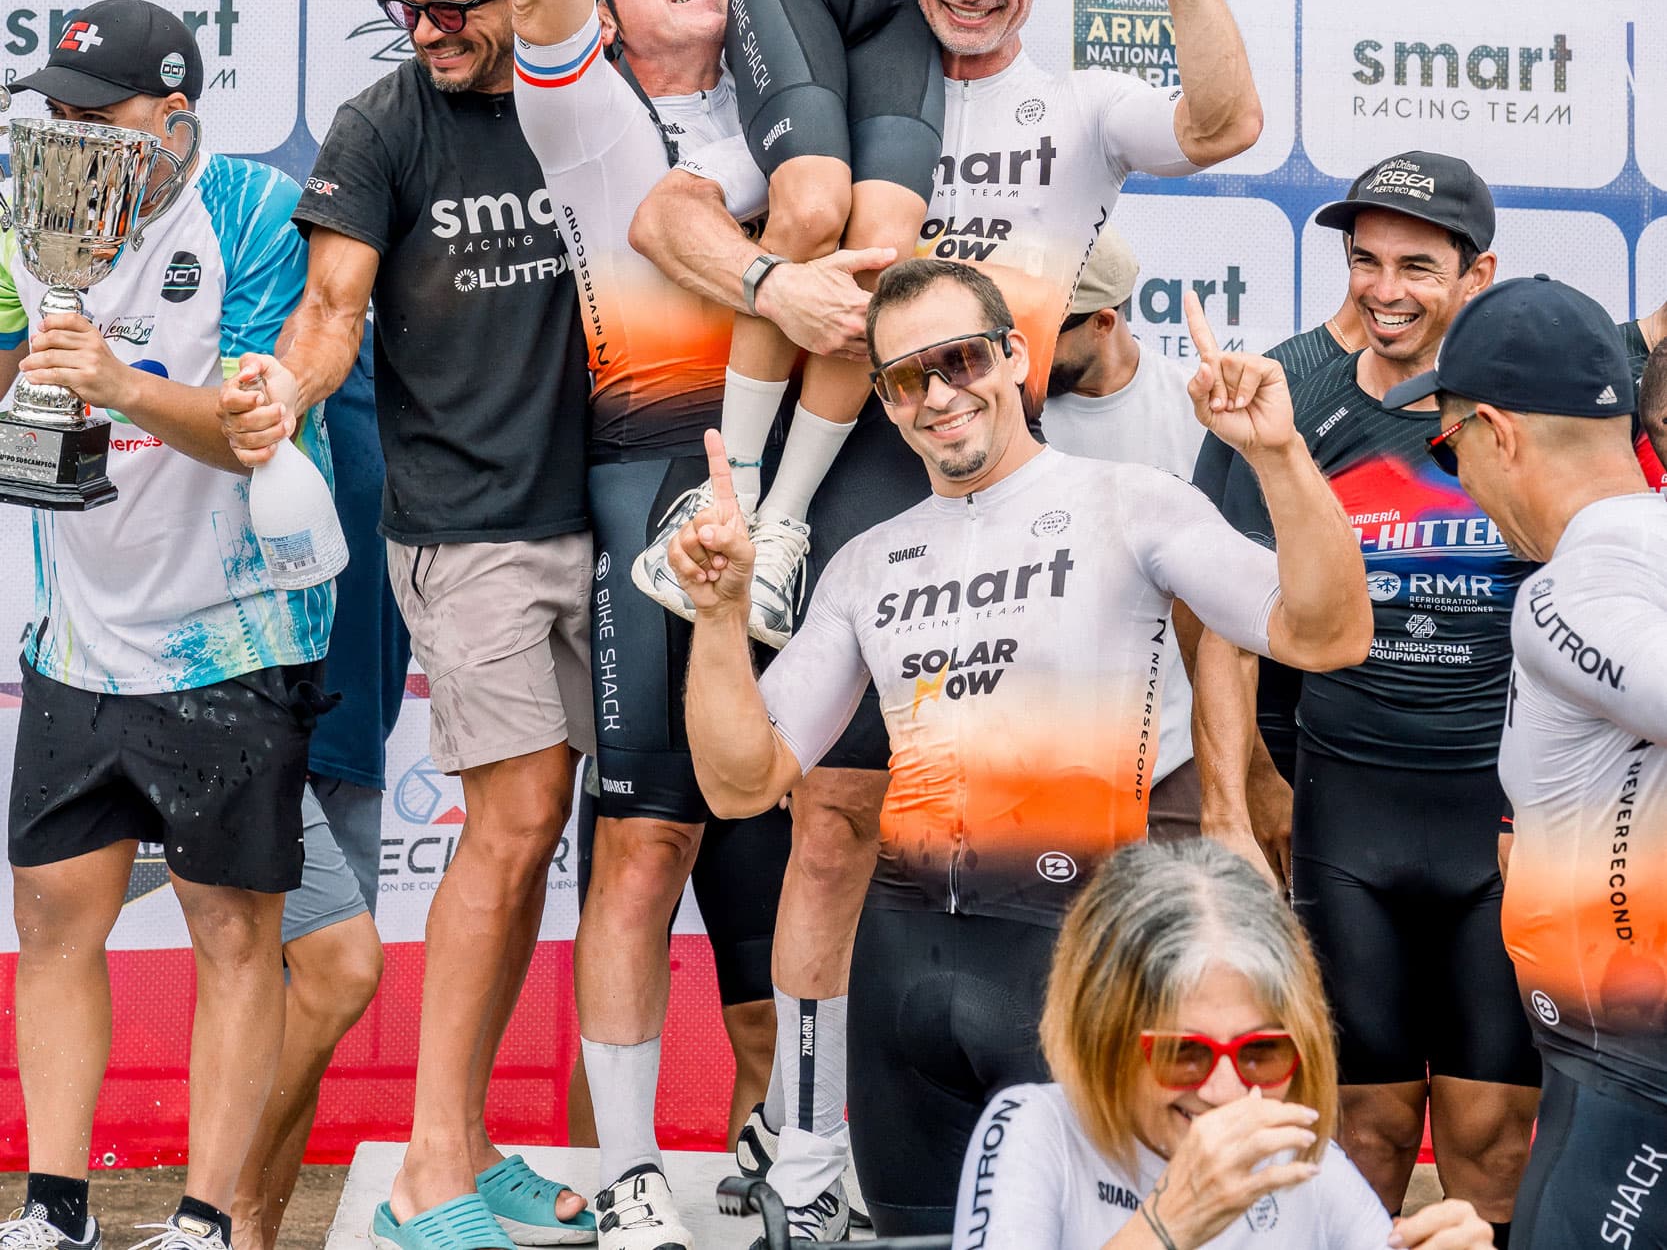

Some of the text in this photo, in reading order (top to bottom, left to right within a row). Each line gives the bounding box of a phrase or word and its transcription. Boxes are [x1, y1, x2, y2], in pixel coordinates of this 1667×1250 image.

[742, 31, 772, 95] SHACK
[1352, 33, 1573, 93] smart
[1353, 95, 1572, 126] RACING TEAM
[762, 117, 793, 151] SUAREZ
[940, 136, 1056, 186] art
[971, 188, 1019, 198] TEAM
[919, 215, 1013, 241] OLAR
[448, 235, 534, 255] RACING
[563, 204, 602, 336] NEVERSECOND
[1125, 266, 1246, 326] art
[1159, 336, 1244, 357] TEM
[888, 544, 928, 565] SUAREZ
[874, 548, 1075, 629] smart
[1409, 573, 1493, 597] RMR
[1409, 595, 1478, 605] REFRIGERATION
[895, 605, 1025, 635] RACING TEAM
[1435, 605, 1494, 613] CONDITIONER
[1369, 649, 1472, 664] EQUIPMENT CORP.
[1371, 638, 1473, 655] ALL INDUSTRIAL
[1530, 592, 1625, 690] LUTRON
[596, 588, 622, 732] BIKE SHACK
[901, 638, 1018, 679] SOLAR
[1135, 652, 1160, 802] NEVERSECOND
[1600, 1143, 1667, 1250] SHACK
